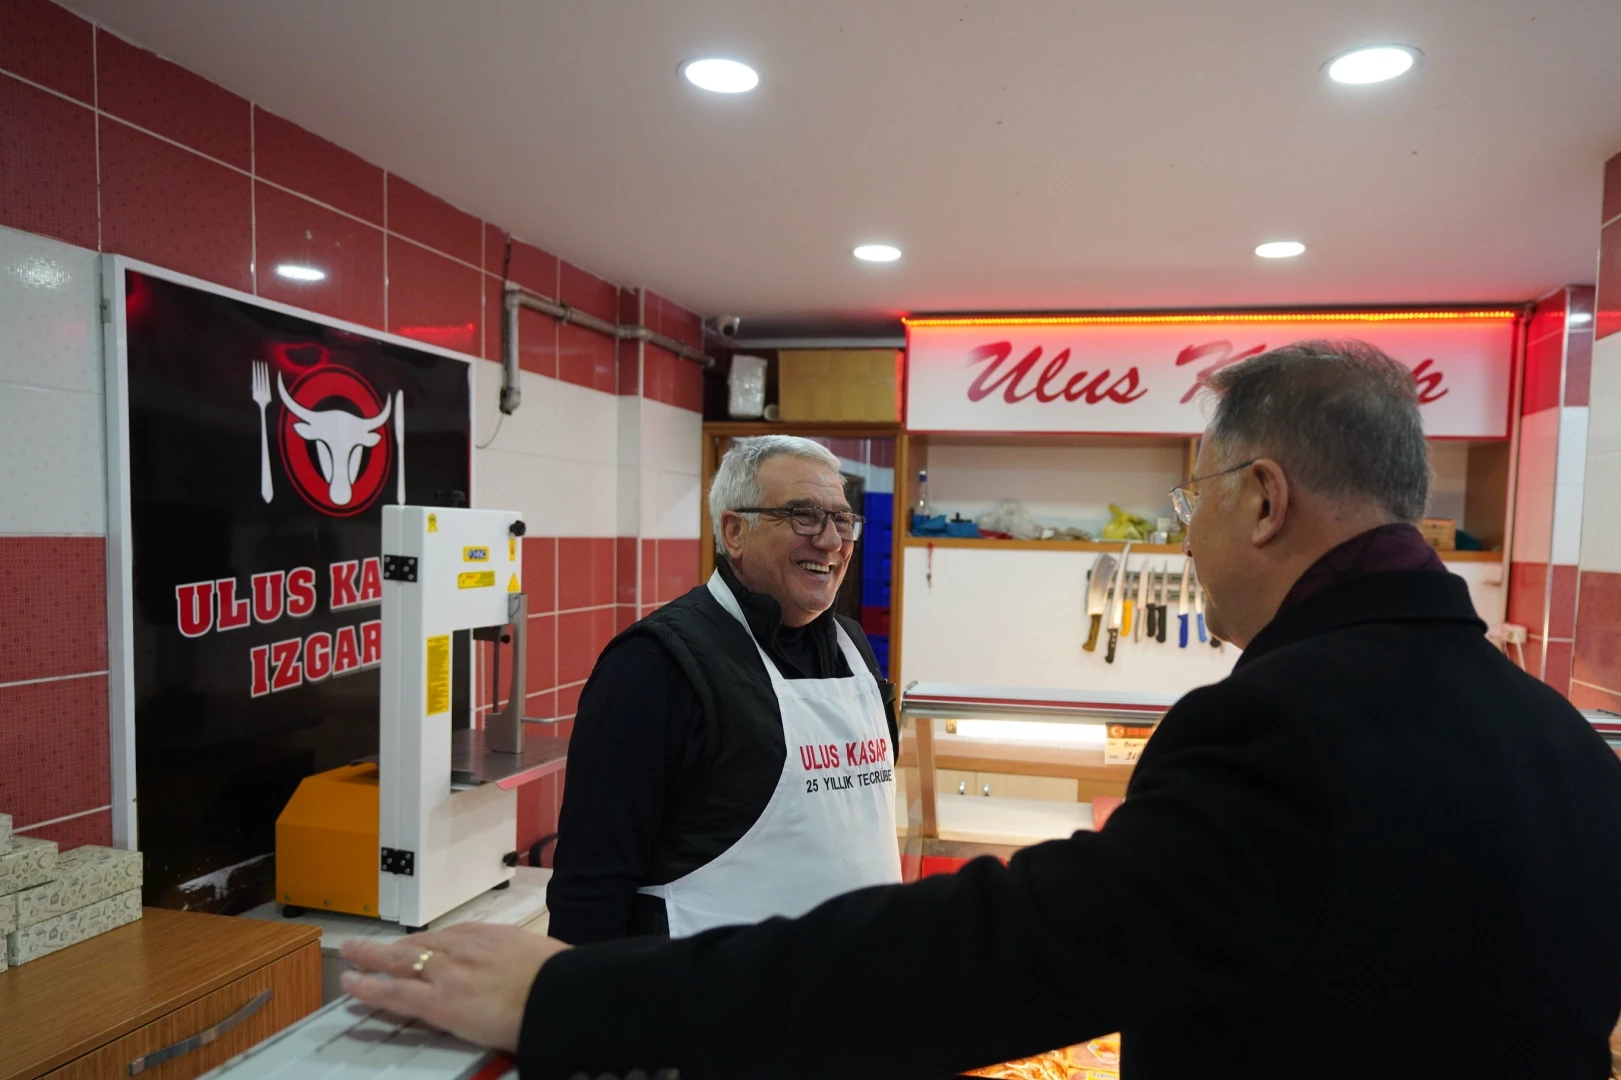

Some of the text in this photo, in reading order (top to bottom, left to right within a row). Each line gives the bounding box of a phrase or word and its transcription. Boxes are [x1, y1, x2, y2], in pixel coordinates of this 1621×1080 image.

[966, 340, 1147, 405] Ulus
[175, 566, 316, 638] ULUS
[799, 738, 887, 771] ULUS KASAP
[806, 768, 893, 793] 25 YILLIK TECRÜBE
